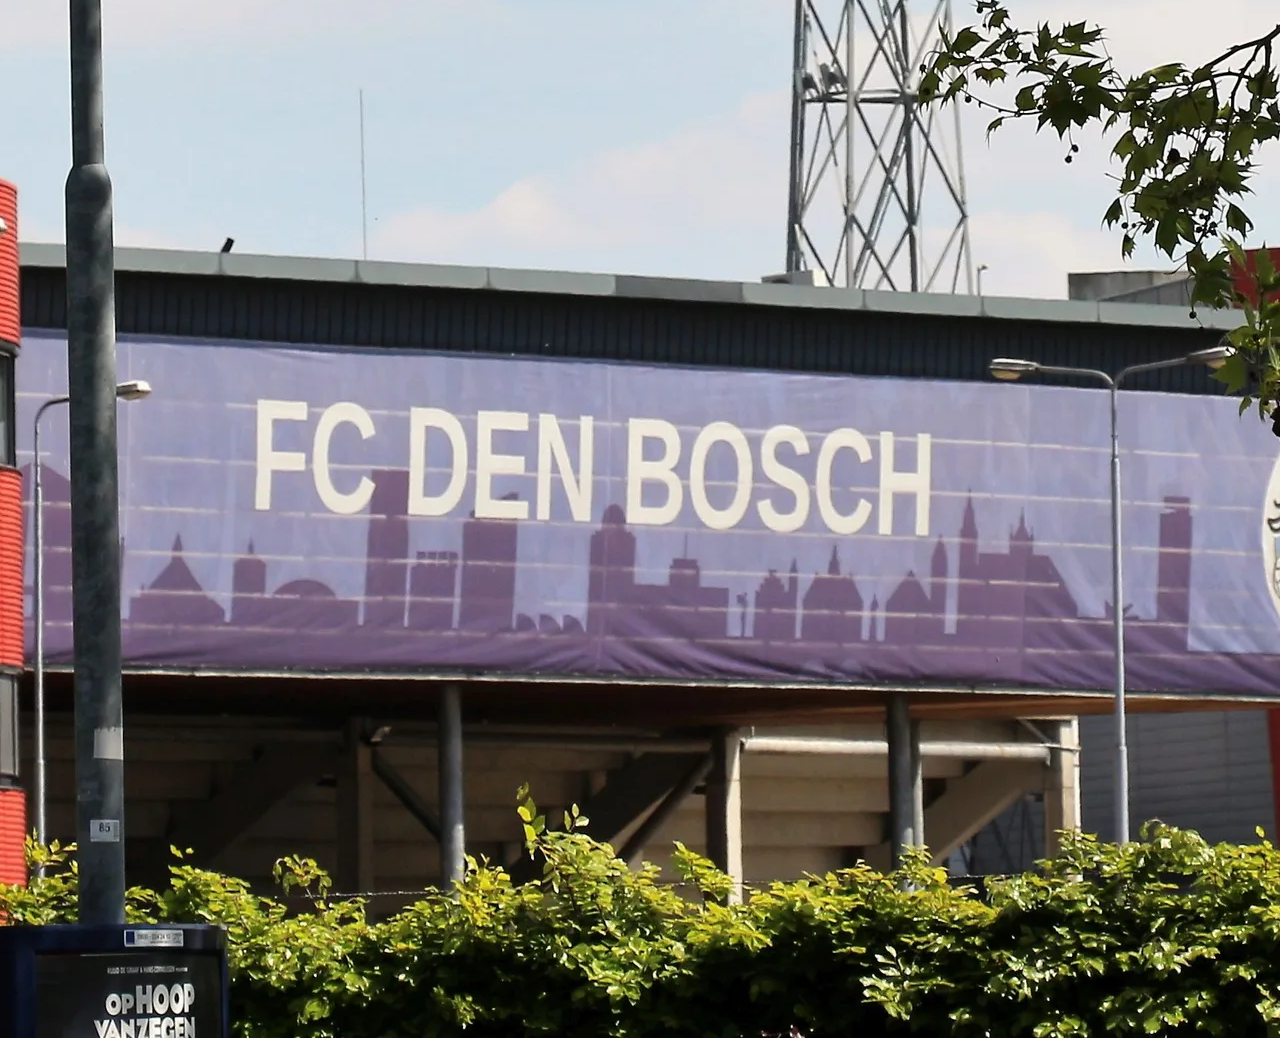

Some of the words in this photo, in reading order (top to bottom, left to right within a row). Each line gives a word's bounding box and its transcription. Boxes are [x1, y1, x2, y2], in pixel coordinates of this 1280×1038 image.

[255, 400, 377, 515] FC
[407, 406, 595, 523] DEN
[626, 417, 932, 537] BOSCH
[105, 993, 135, 1016] OP
[135, 983, 195, 1015] HOOP
